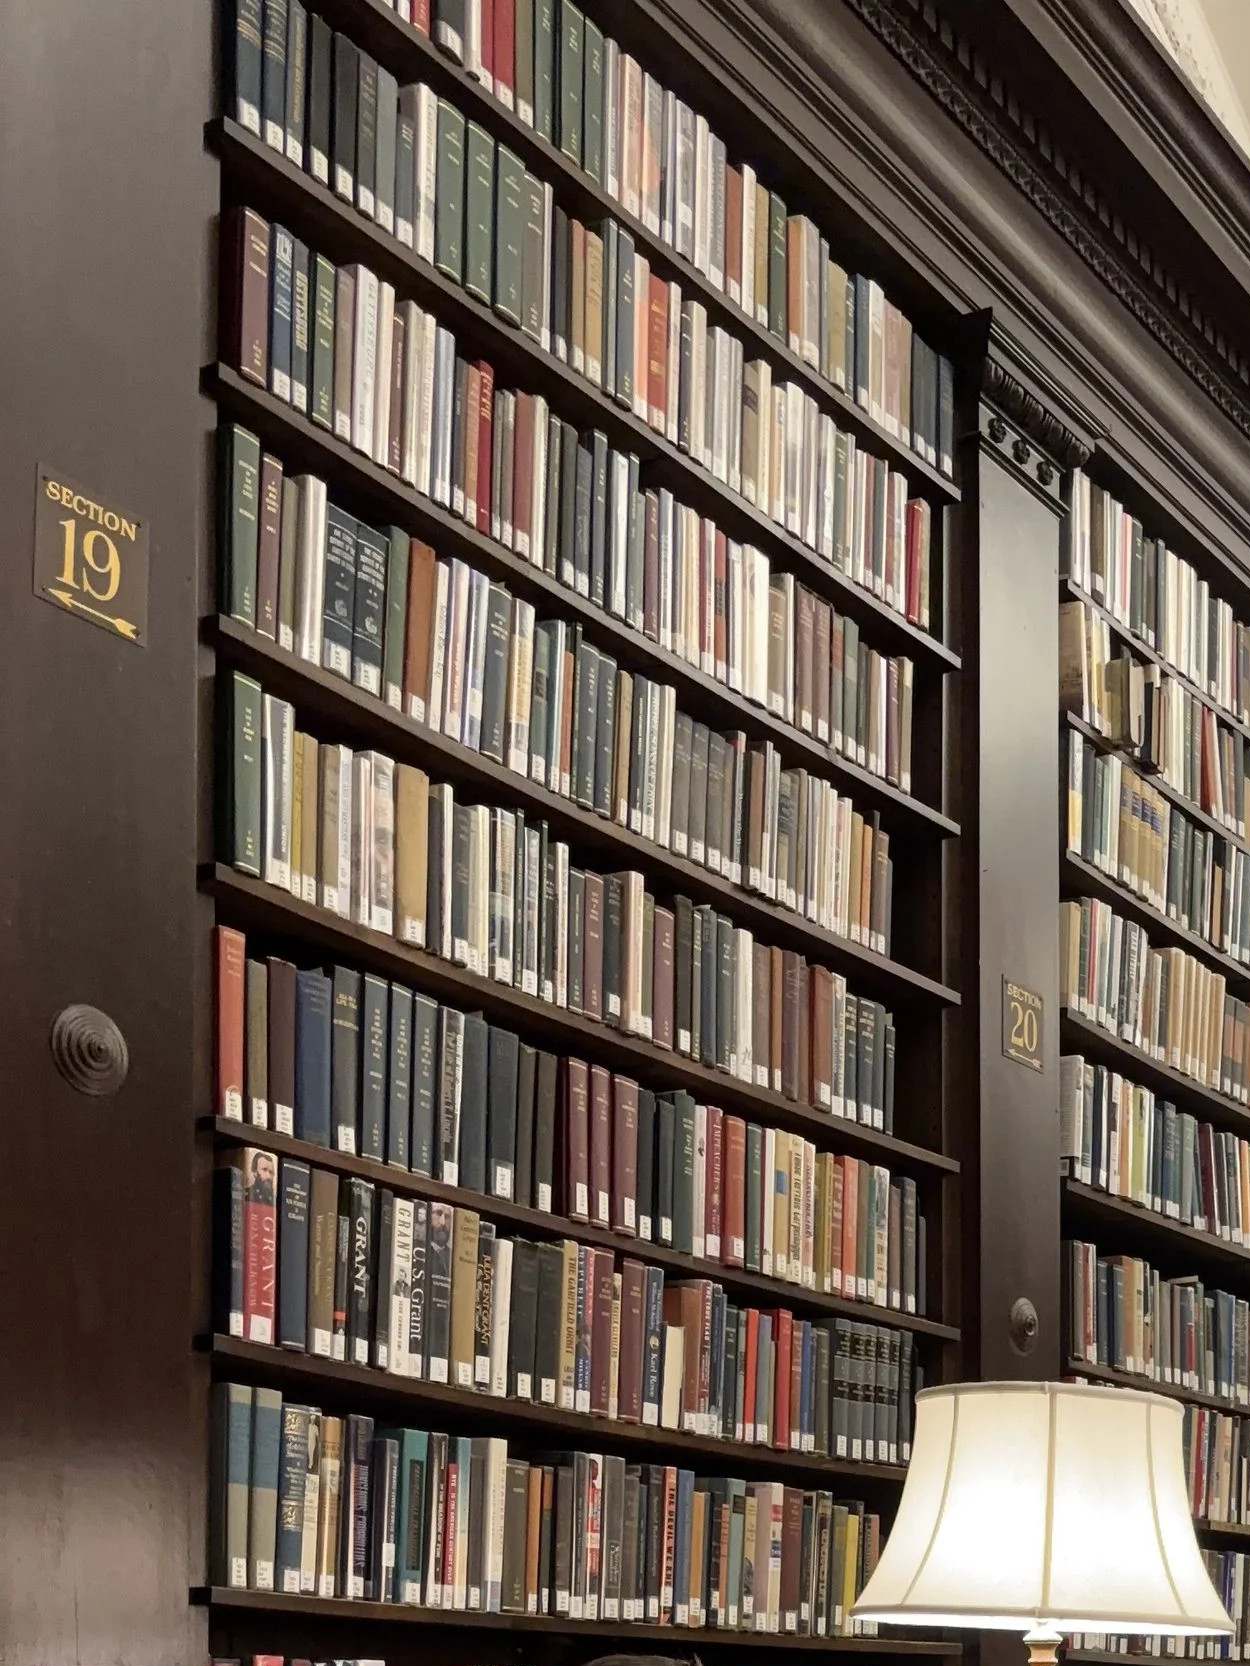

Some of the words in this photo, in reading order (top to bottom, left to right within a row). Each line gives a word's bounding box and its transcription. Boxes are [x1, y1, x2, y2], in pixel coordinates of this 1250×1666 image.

[46, 481, 137, 542] SECTION
[56, 519, 121, 601] 19
[1007, 984, 1042, 1010] SECTION
[1010, 1002, 1038, 1053] 20
[354, 1216, 368, 1299] GRANT
[396, 1207, 411, 1262] GRANT
[261, 1216, 276, 1313] GRANT
[568, 1257, 577, 1277] THE
[410, 1288, 425, 1342] Grant
[566, 1278, 577, 1324] GARFIELD
[565, 1327, 575, 1355] ORBIT
[650, 1353, 658, 1372] Karl
[667, 1510, 675, 1541] DEVIL
[664, 1566, 672, 1587] KNE
